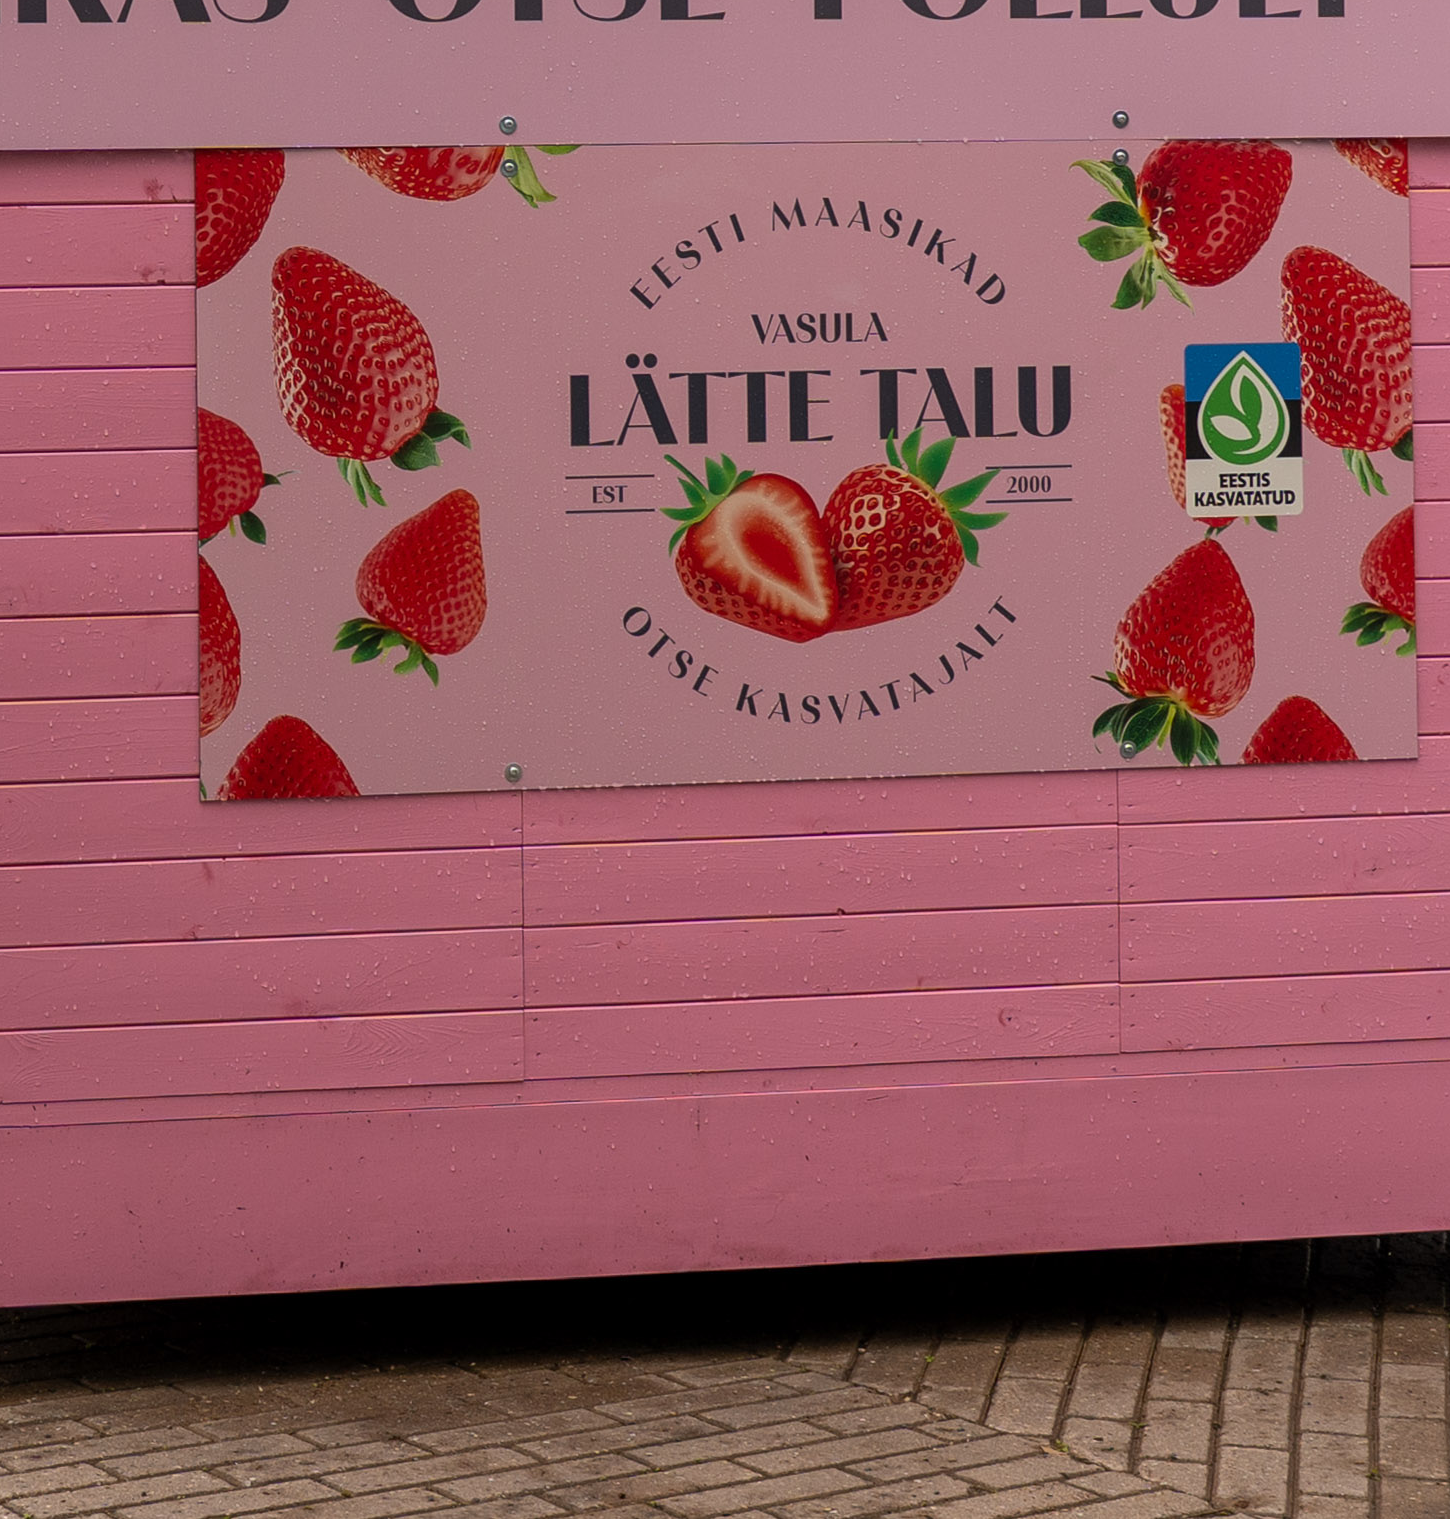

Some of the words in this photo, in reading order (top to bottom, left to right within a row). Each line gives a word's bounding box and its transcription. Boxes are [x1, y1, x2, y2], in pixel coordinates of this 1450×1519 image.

[630, 213, 746, 310] EESTI
[771, 197, 1006, 305] MAASIKAD
[751, 312, 888, 345] VASULA
[570, 354, 833, 446] LÄTTE
[860, 366, 1072, 441] TALU
[593, 485, 628, 504] EST
[1007, 476, 1051, 493] 2000
[1219, 473, 1270, 488] EESTIS
[1195, 490, 1295, 506] KASVATATUD
[622, 605, 720, 697] OTSE
[735, 594, 1019, 725] KASVATAJALT
